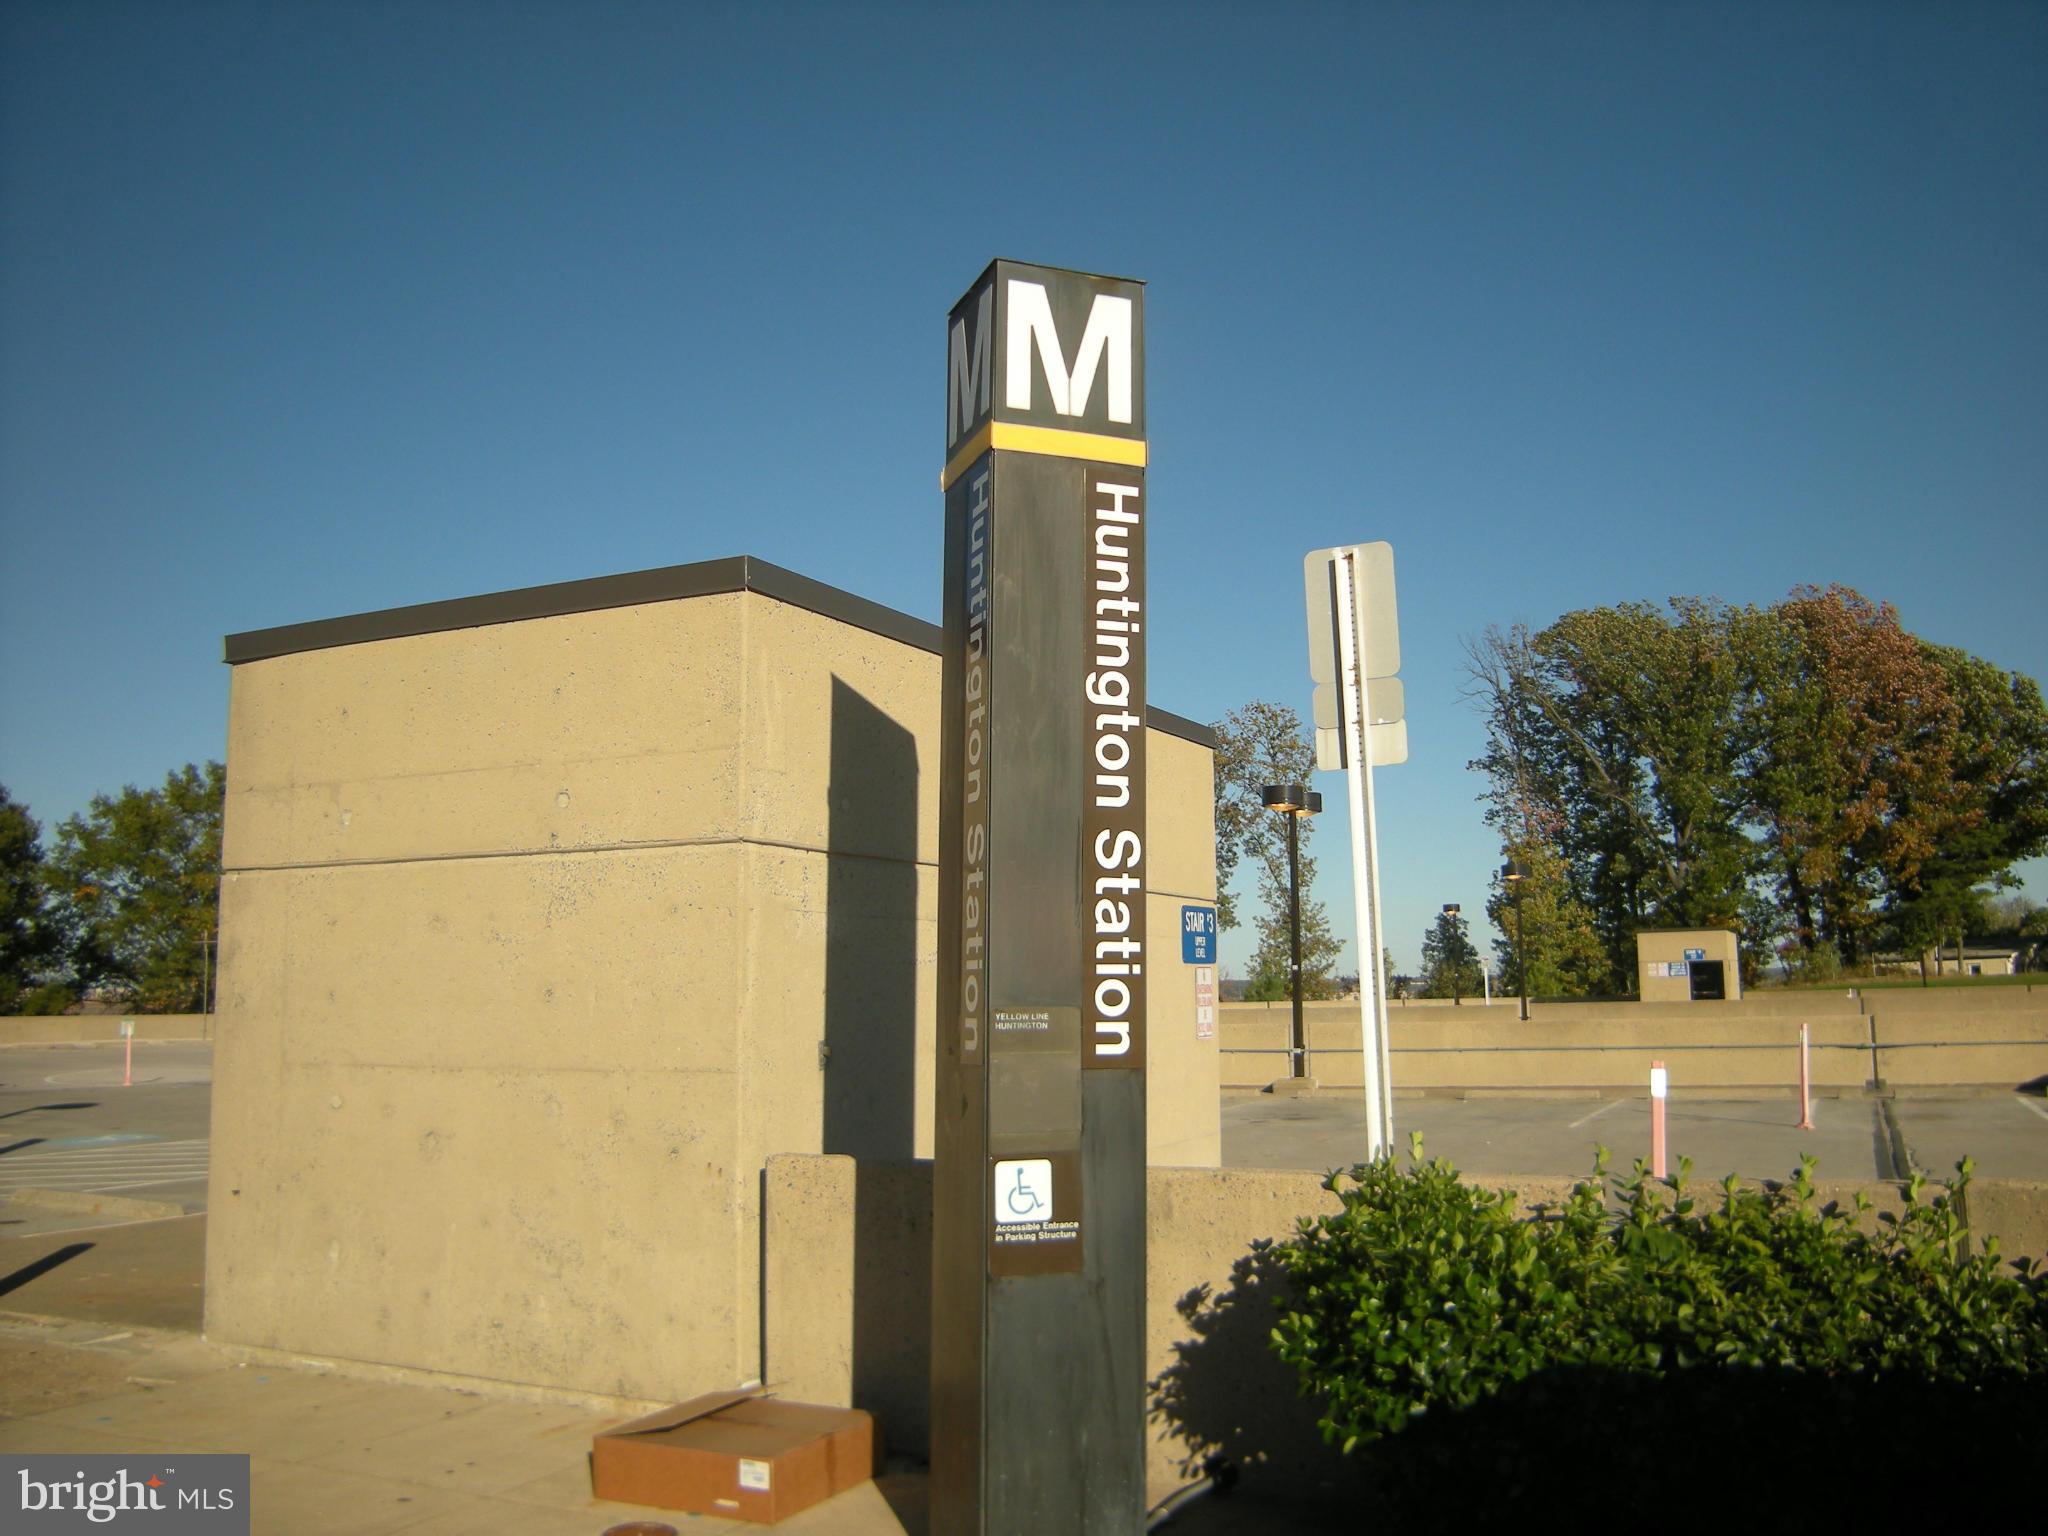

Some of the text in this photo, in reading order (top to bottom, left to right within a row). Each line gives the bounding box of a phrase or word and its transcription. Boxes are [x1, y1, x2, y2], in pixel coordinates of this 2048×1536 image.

[1006, 279, 1132, 424] M
[949, 283, 993, 448] M
[964, 470, 988, 1051] Huntington Station
[1085, 482, 1142, 1055] Huntington Station
[1185, 911, 1205, 932] STAIR
[995, 1012, 1049, 1020] YELLOW LINE
[995, 1021, 1048, 1030] HUNTINGTON
[995, 1220, 1079, 1232] Accessible Entrance
[995, 1229, 1077, 1242] in Parking Structure
